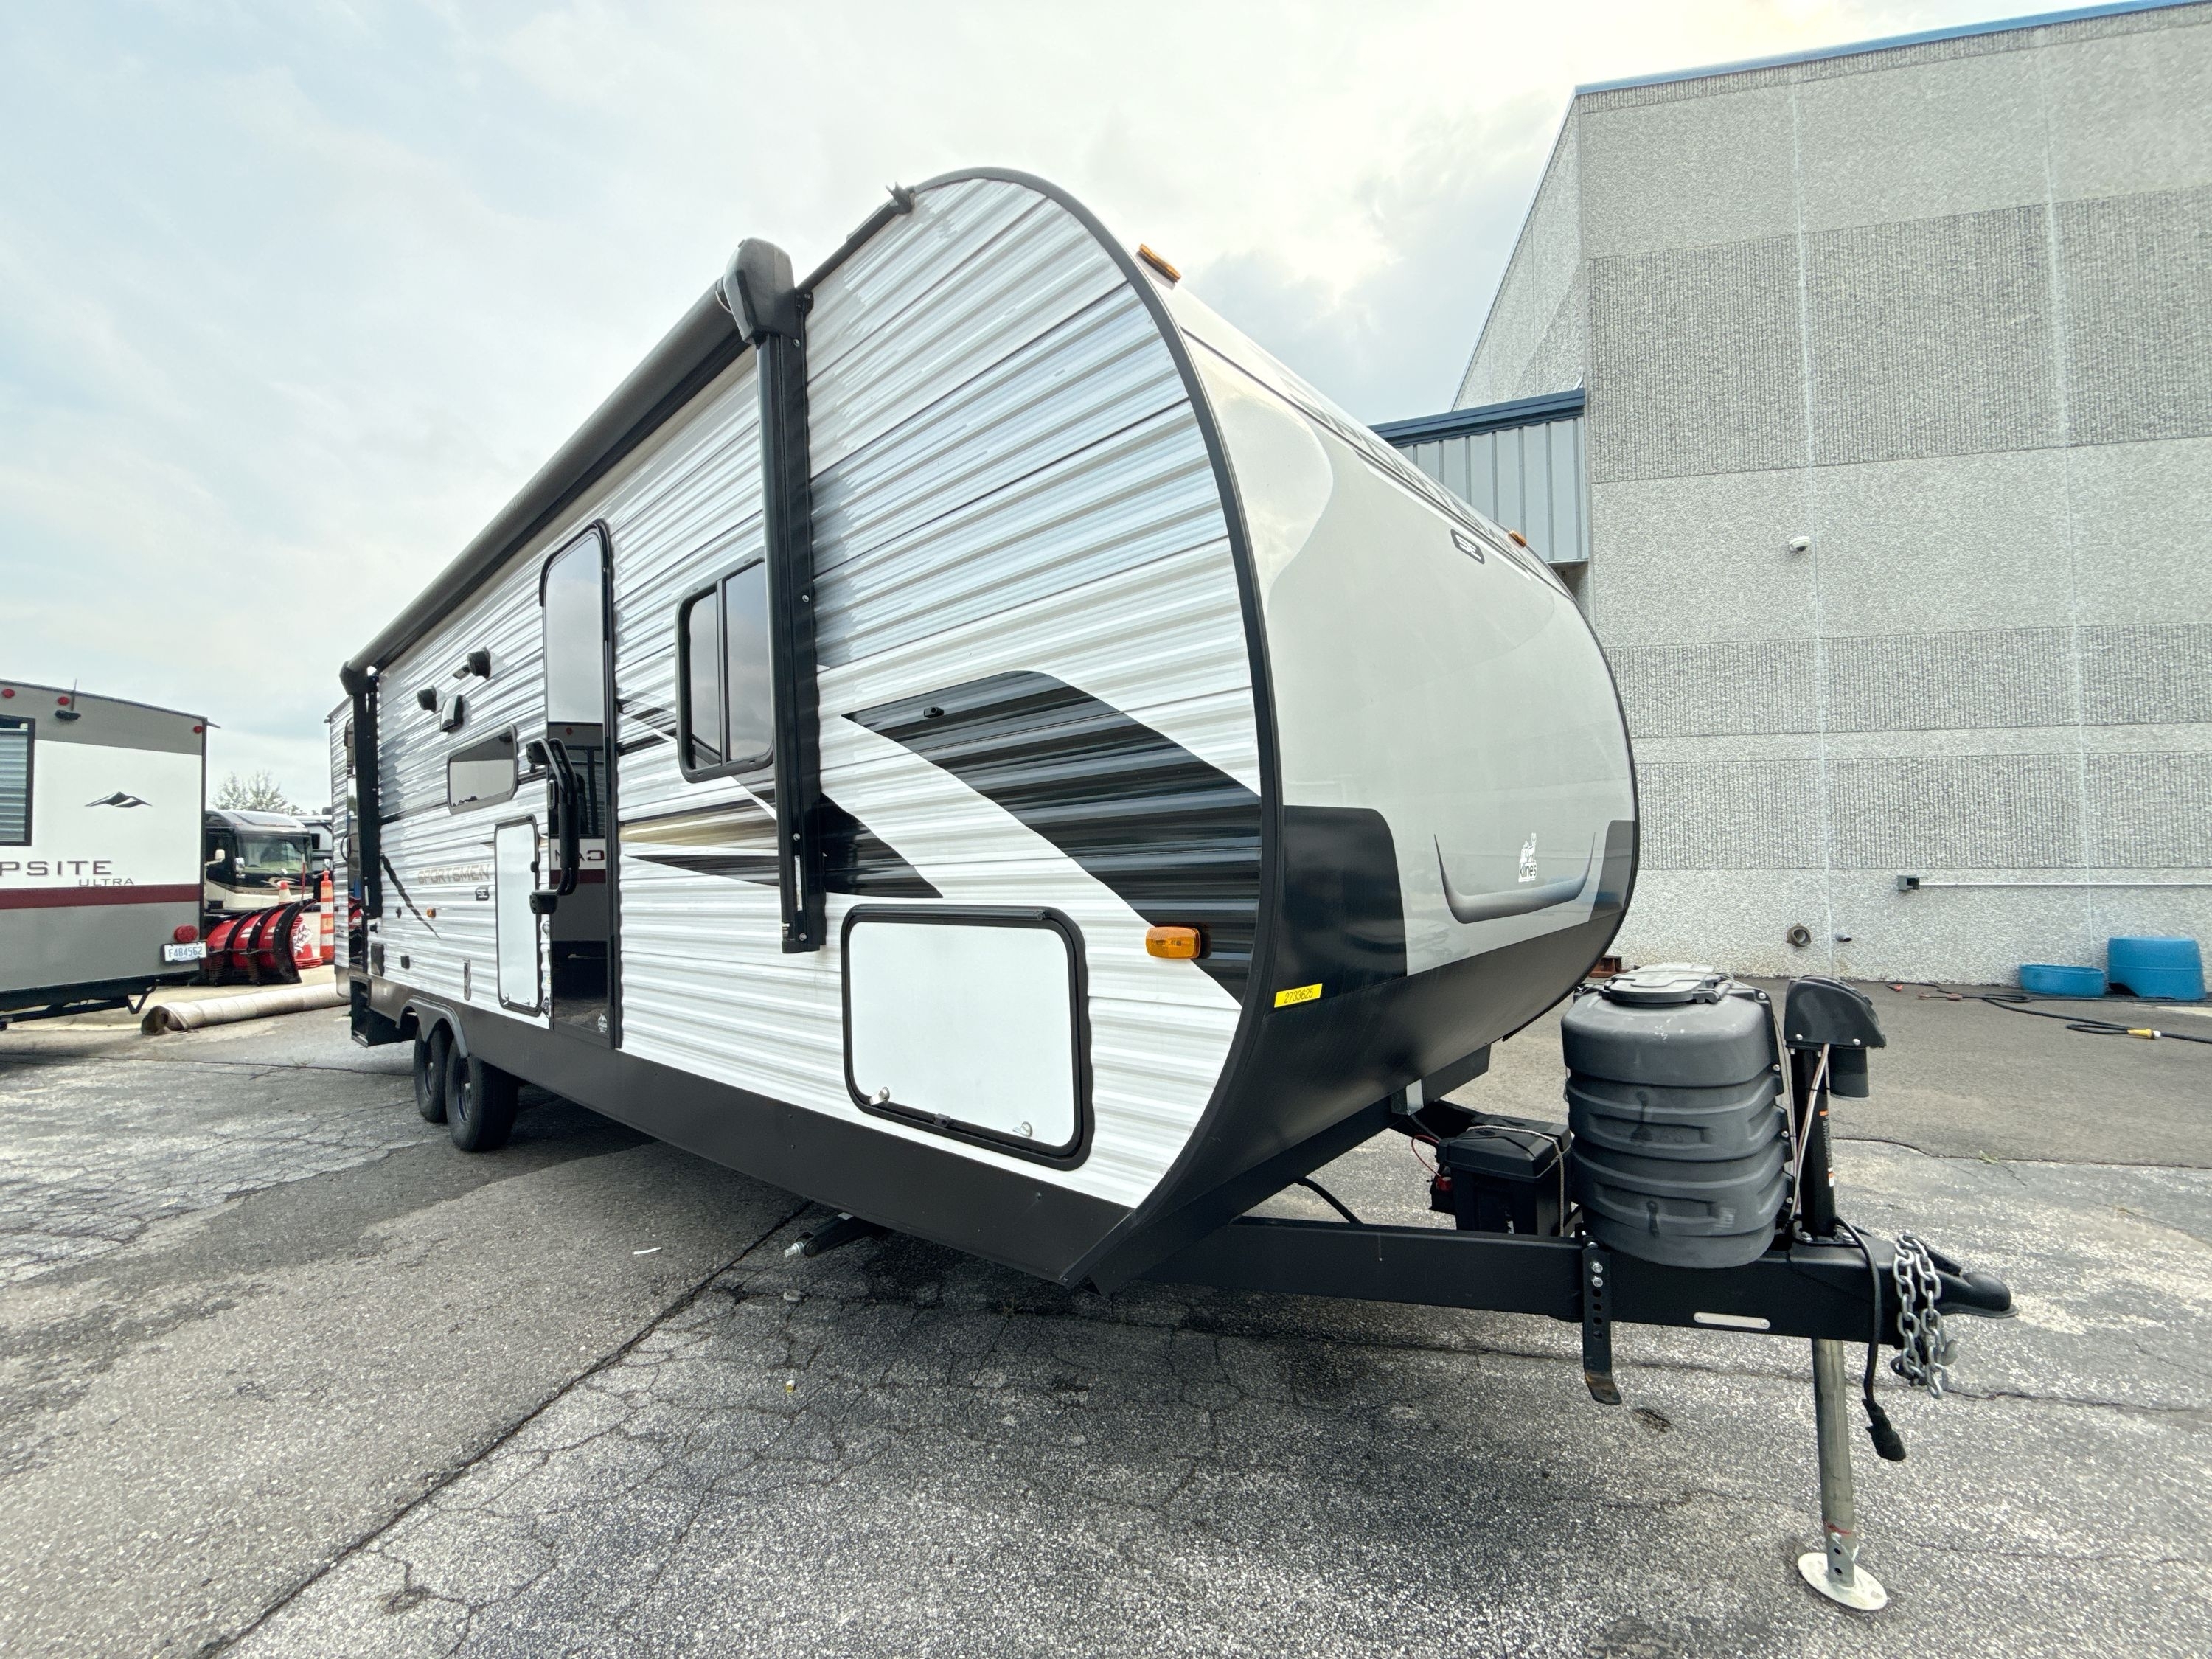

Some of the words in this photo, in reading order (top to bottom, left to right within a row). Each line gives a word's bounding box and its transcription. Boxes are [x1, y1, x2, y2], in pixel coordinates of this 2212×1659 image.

[79, 878, 134, 886] ULTRA
[418, 864, 490, 884] SPORTSMEN
[1284, 988, 1314, 1004] 2733625
